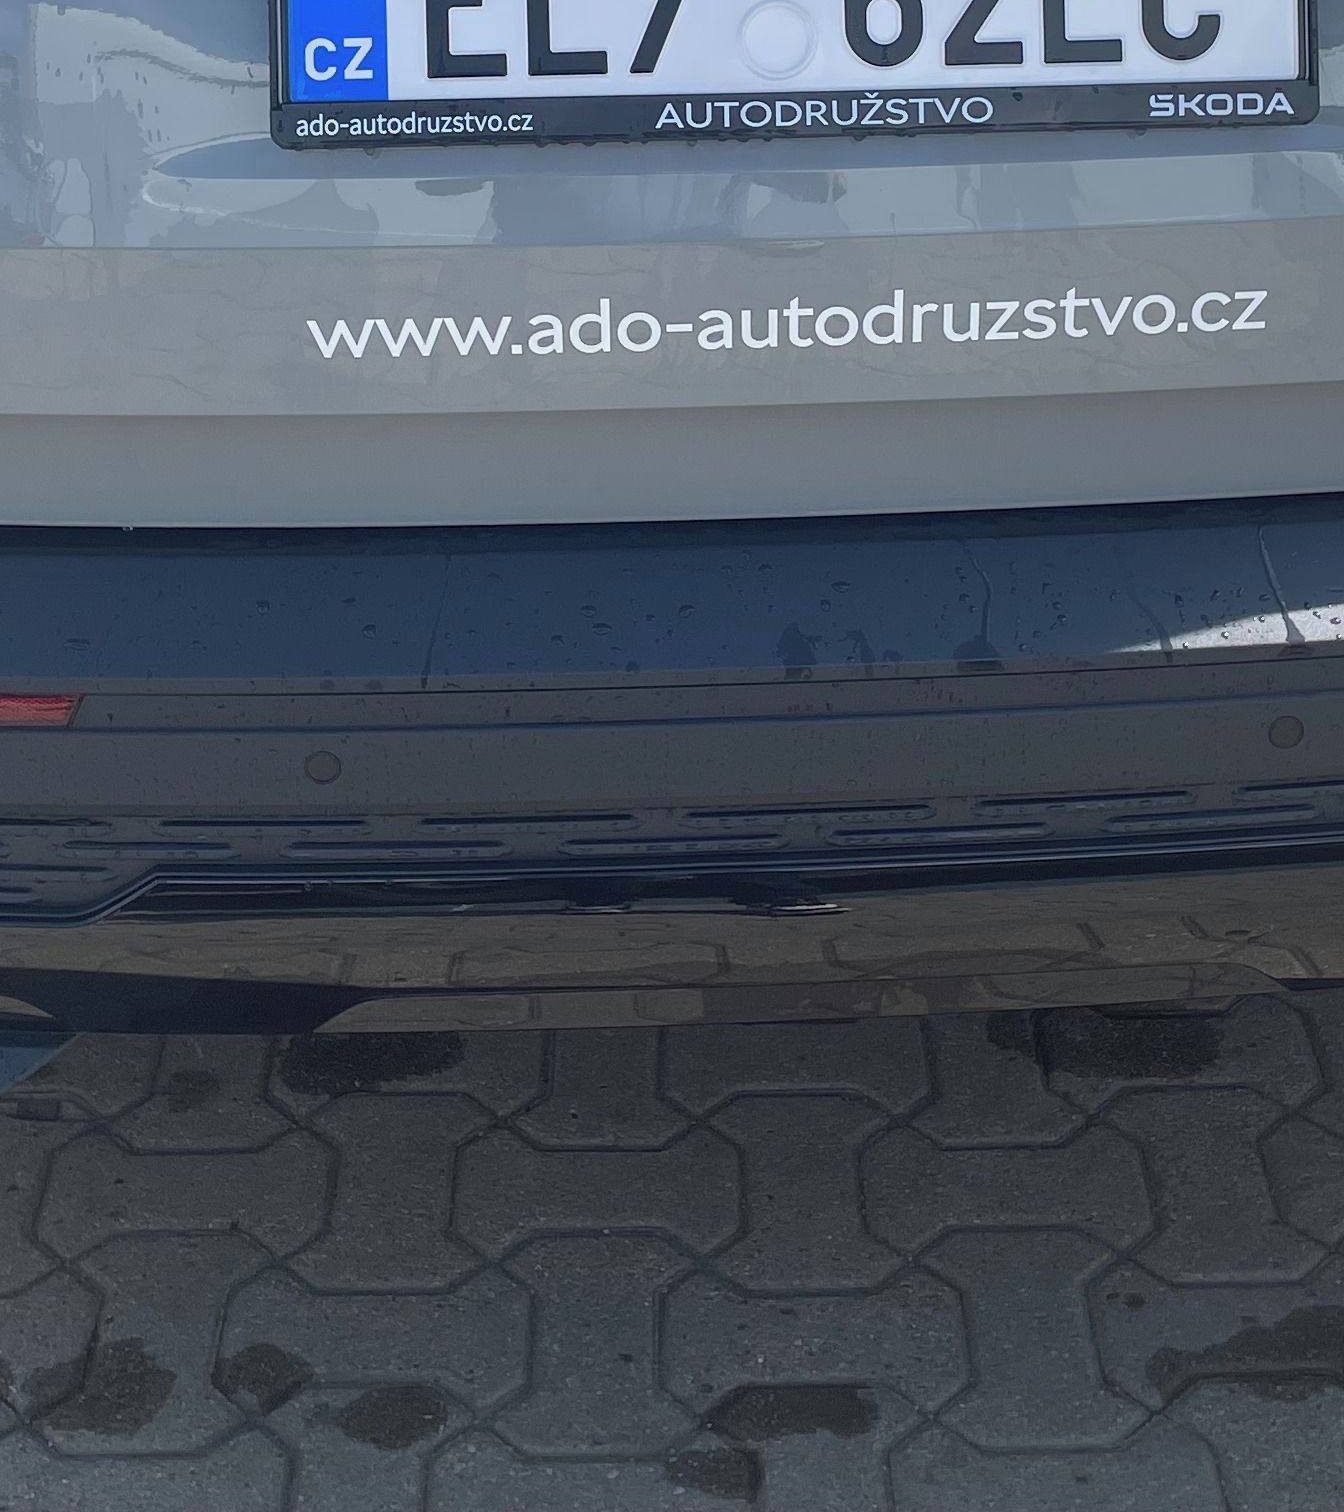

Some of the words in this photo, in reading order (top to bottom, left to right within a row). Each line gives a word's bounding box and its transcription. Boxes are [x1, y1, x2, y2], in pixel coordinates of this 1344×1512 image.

[304, 37, 374, 81] CZ
[296, 111, 534, 137] ado-autodruzstvo.cz
[656, 91, 994, 129] AUTODRUŽSTVO
[306, 285, 1269, 360] www.ado-autodruzstvo.cz
